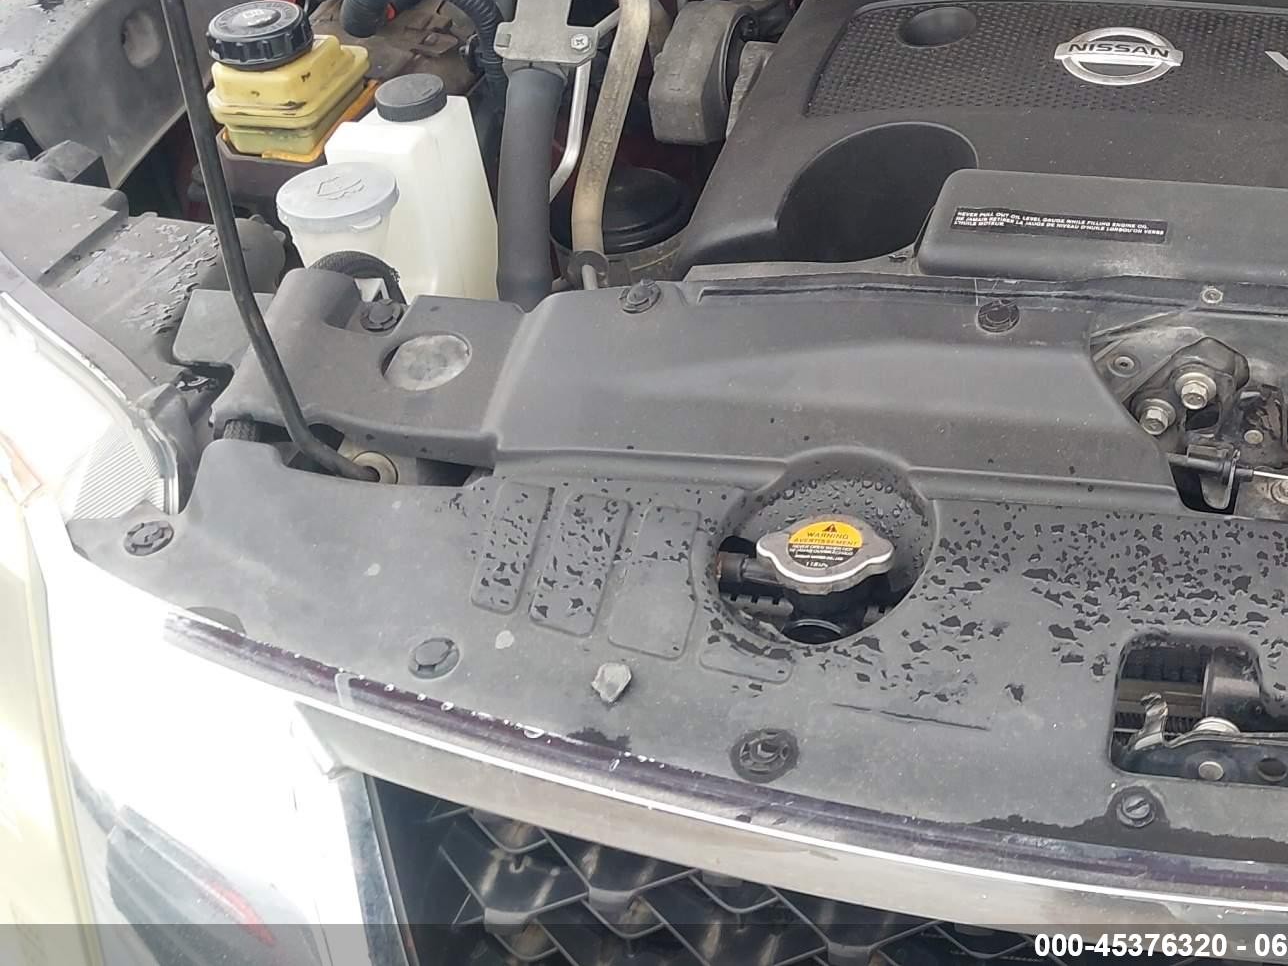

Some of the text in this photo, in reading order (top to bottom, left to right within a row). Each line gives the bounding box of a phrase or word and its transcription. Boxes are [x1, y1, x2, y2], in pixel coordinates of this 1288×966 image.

[1068, 41, 1170, 59] NISSAN
[807, 531, 849, 539] WARNING
[794, 537, 858, 546] AVERTISSEMENT
